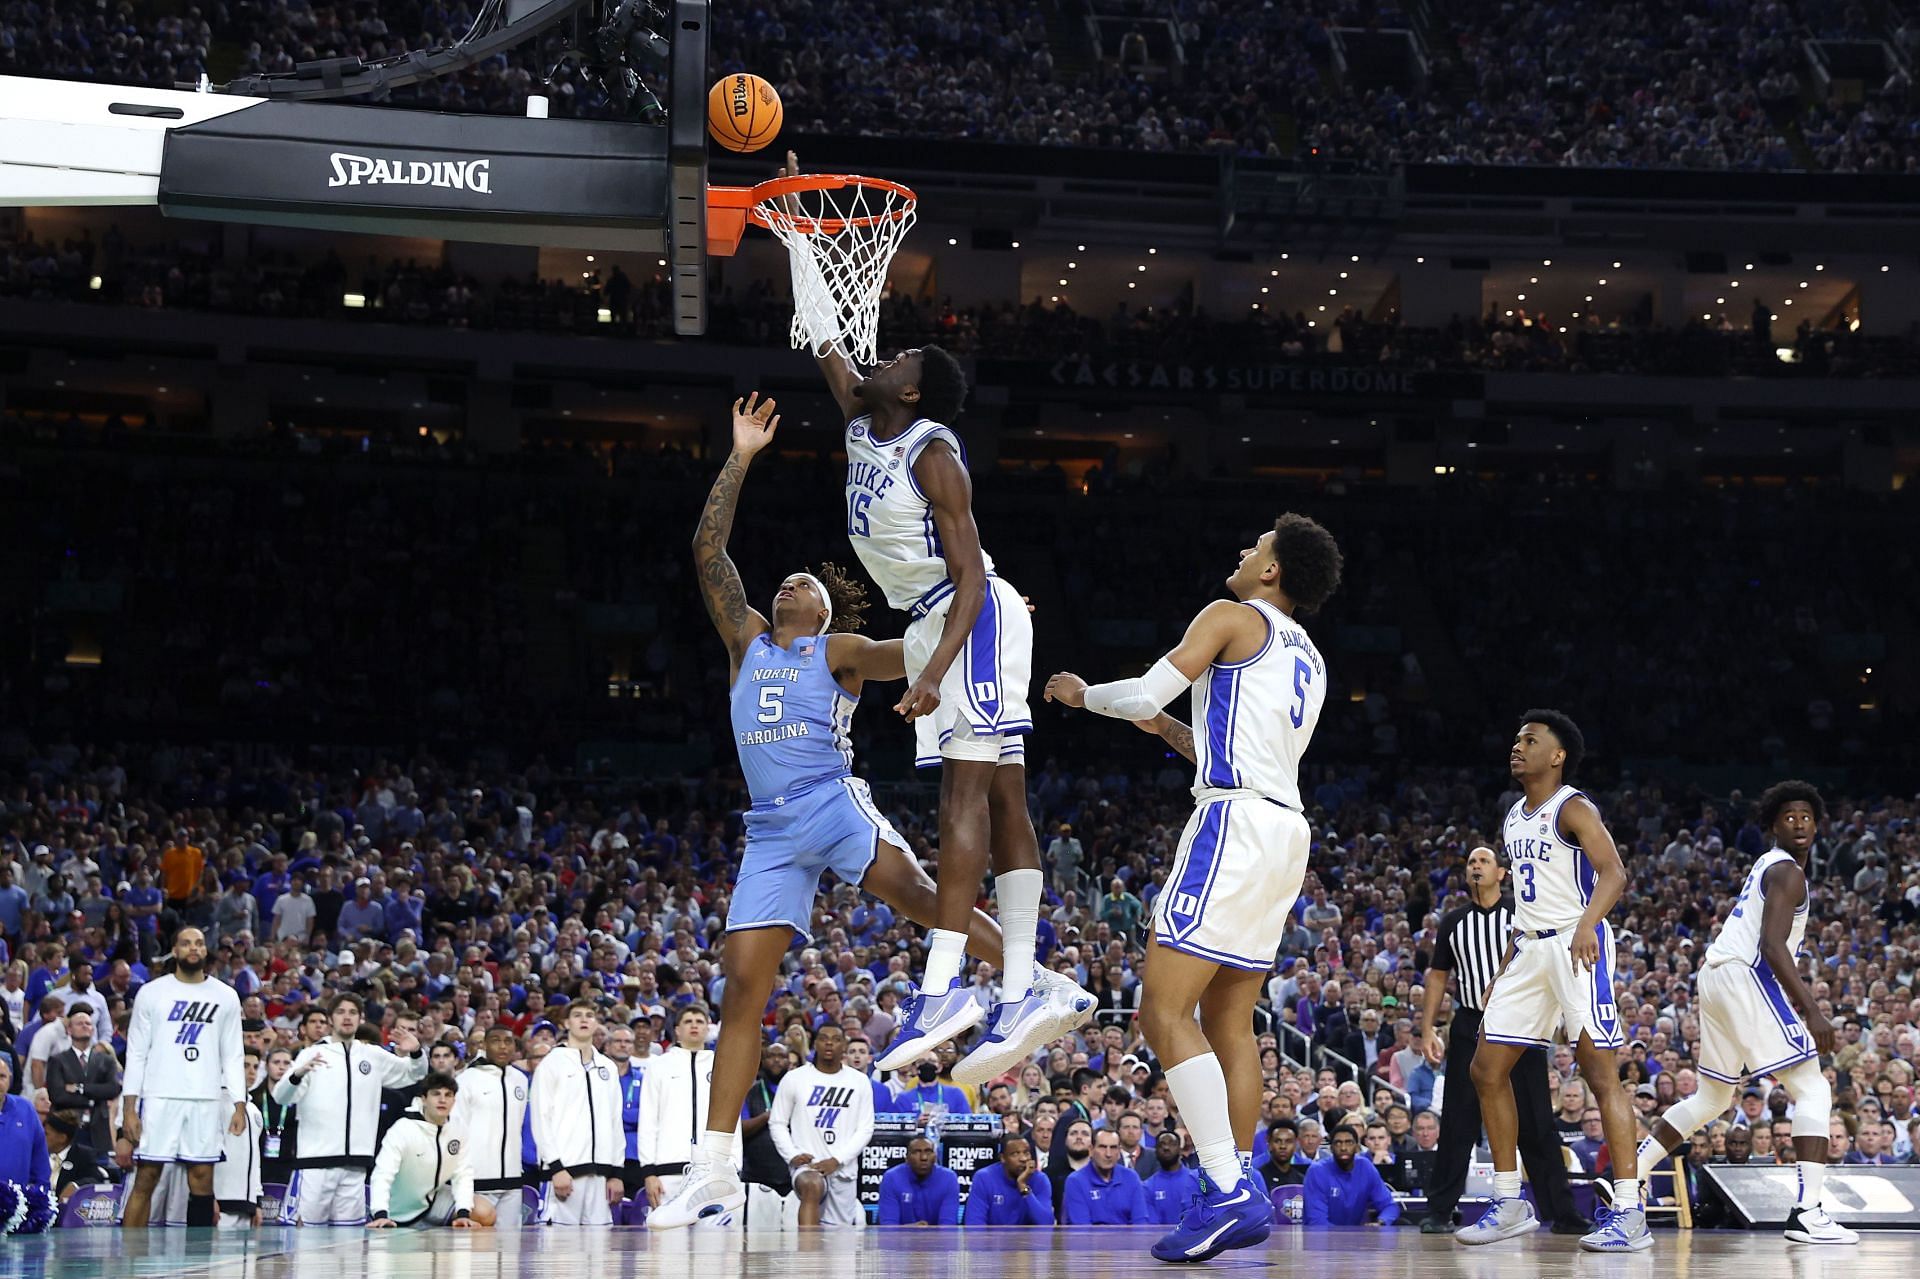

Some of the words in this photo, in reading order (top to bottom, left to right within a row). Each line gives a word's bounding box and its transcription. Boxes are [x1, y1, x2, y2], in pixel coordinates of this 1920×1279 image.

[328, 152, 492, 194] SPALDING
[1050, 361, 1218, 389] CAESARS
[1227, 366, 1416, 393] SUPERDOME
[847, 462, 894, 501] DUKE
[848, 490, 870, 538] 15
[751, 668, 800, 683] NORTH
[757, 686, 785, 723] 5
[1290, 655, 1311, 730] 5
[740, 721, 809, 745] CAROLINA
[1505, 838, 1552, 863] DUKE
[1519, 863, 1536, 903] 3
[167, 1000, 219, 1023] BALL
[806, 1085, 855, 1108] BALL
[861, 1146, 907, 1159] POWER
[861, 1157, 888, 1170] ADE
[948, 1147, 993, 1160] POWER
[948, 1158, 975, 1170] ADE
